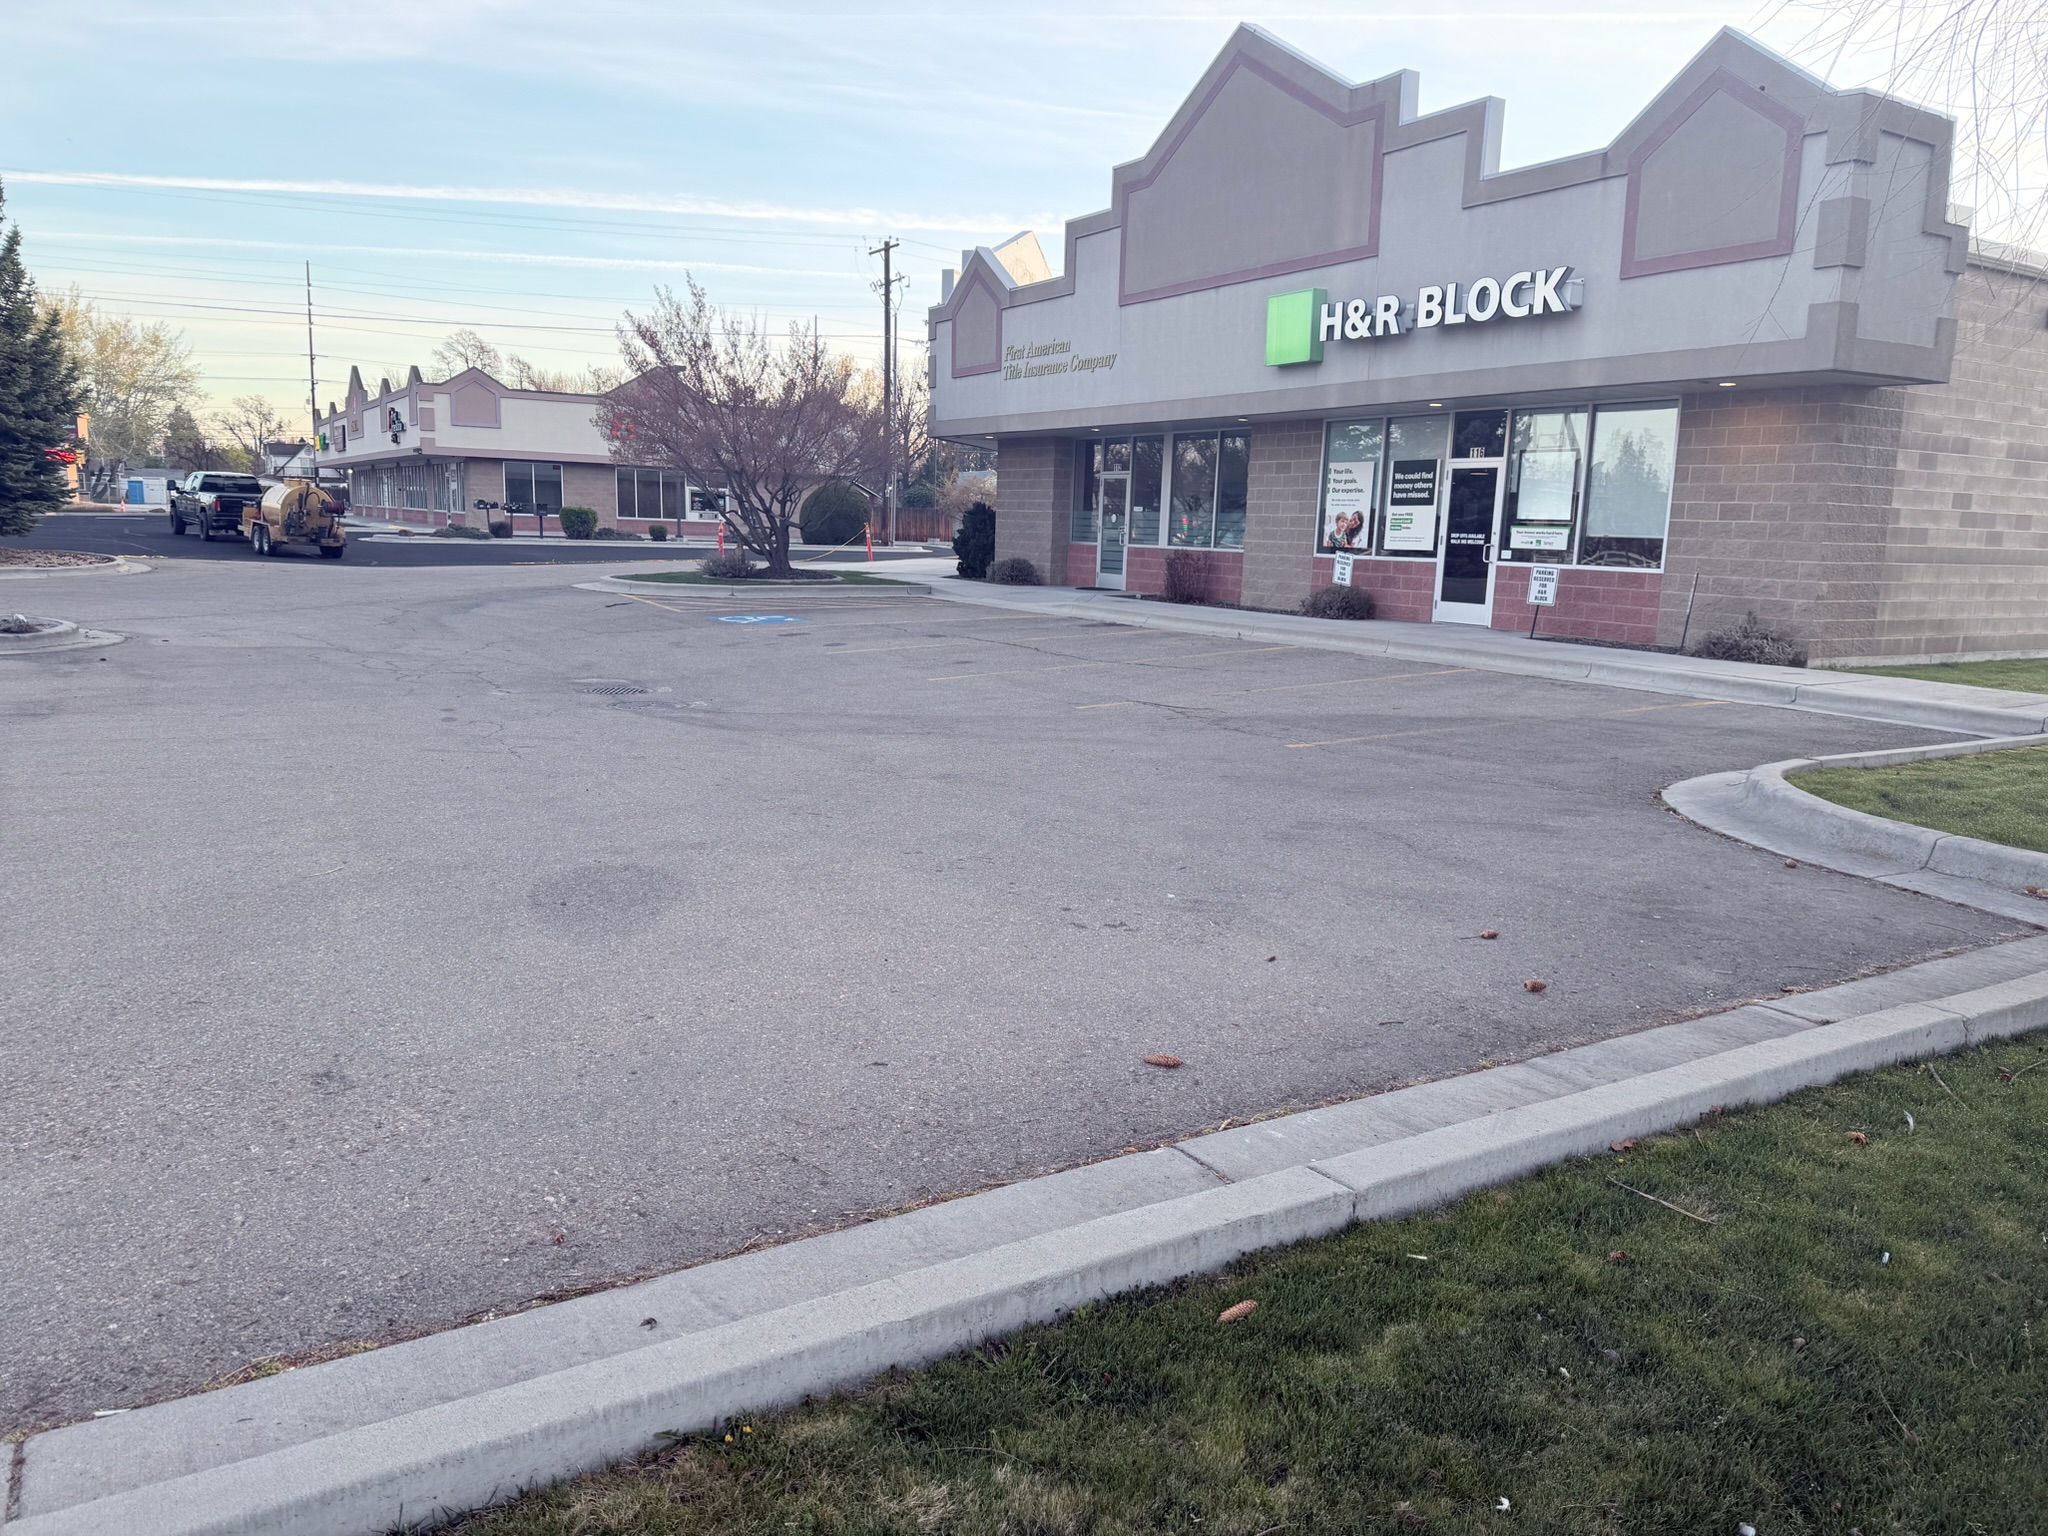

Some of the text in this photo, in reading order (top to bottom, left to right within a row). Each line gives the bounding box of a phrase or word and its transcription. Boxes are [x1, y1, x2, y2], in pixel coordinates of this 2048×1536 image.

[1319, 265, 1573, 342] H&R BLOCK
[1004, 338, 1071, 362] First American
[1003, 353, 1117, 381] Title Insurance Company
[1394, 471, 1434, 480] We could find
[1413, 481, 1433, 489] others
[1392, 490, 1430, 499] have missed.
